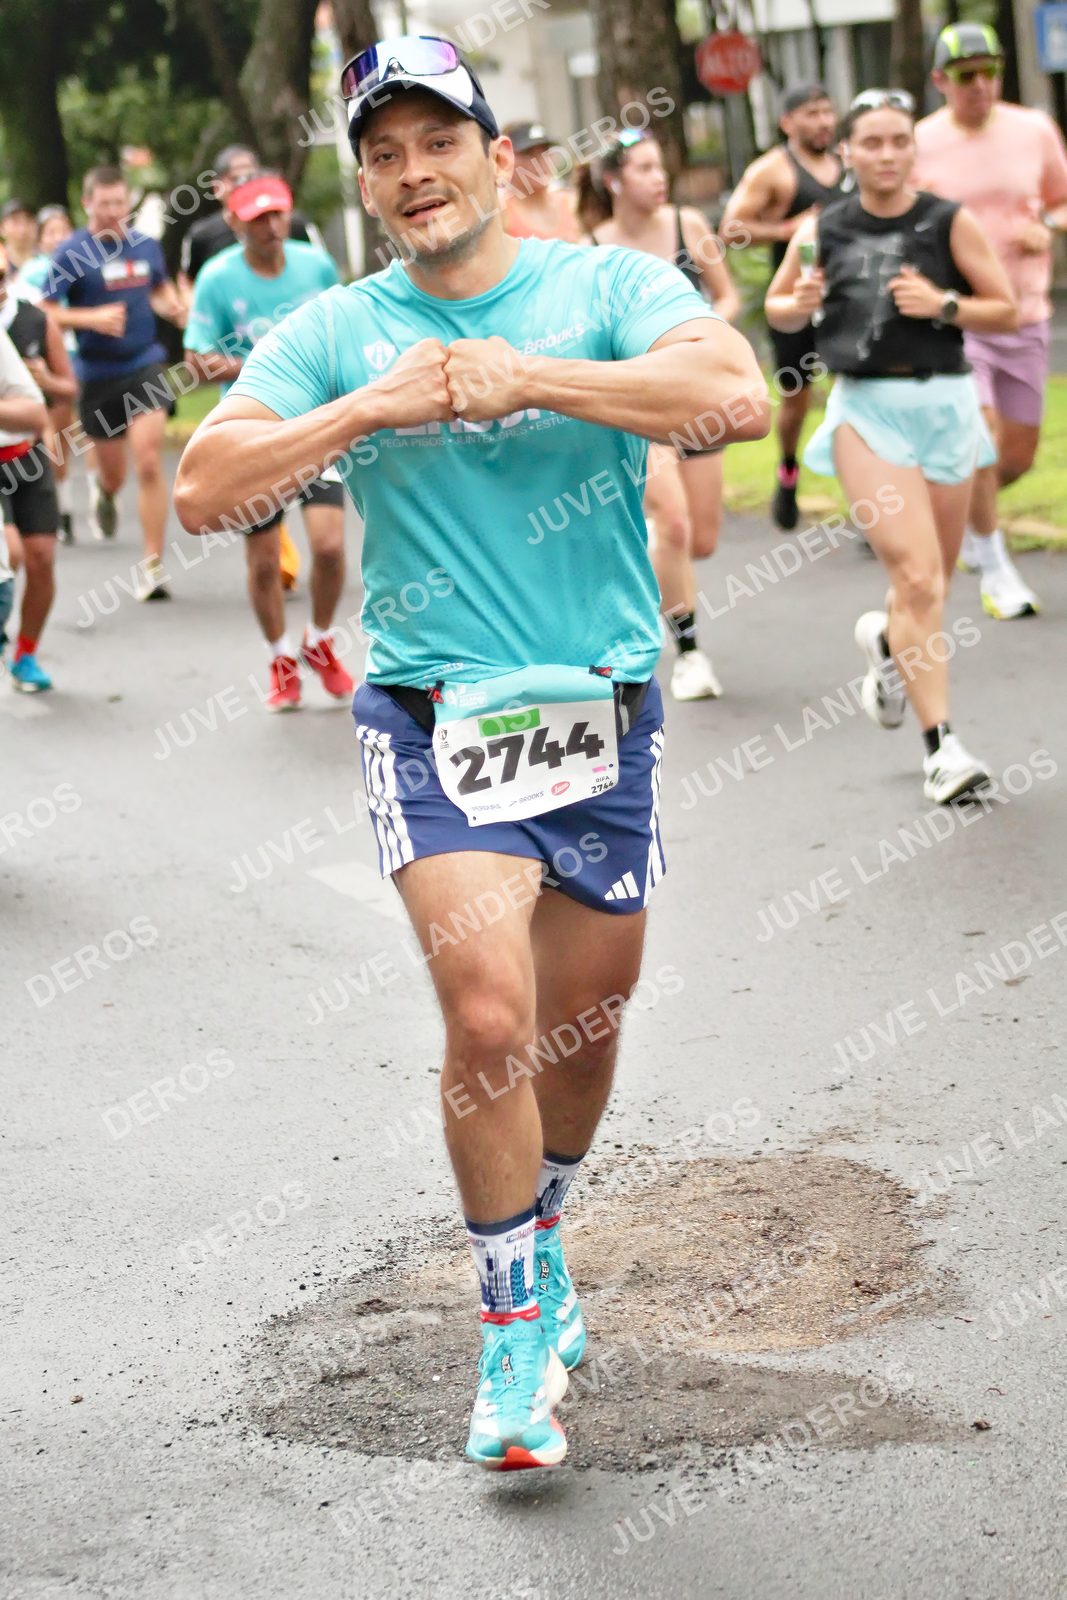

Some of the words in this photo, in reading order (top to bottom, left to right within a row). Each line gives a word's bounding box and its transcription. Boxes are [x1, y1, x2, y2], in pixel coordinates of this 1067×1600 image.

[524, 323, 585, 354] BROOKS
[380, 438, 408, 448] PEGA
[411, 438, 446, 448] PISOS
[449, 722, 605, 796] 2744
[591, 781, 614, 794] 2744
